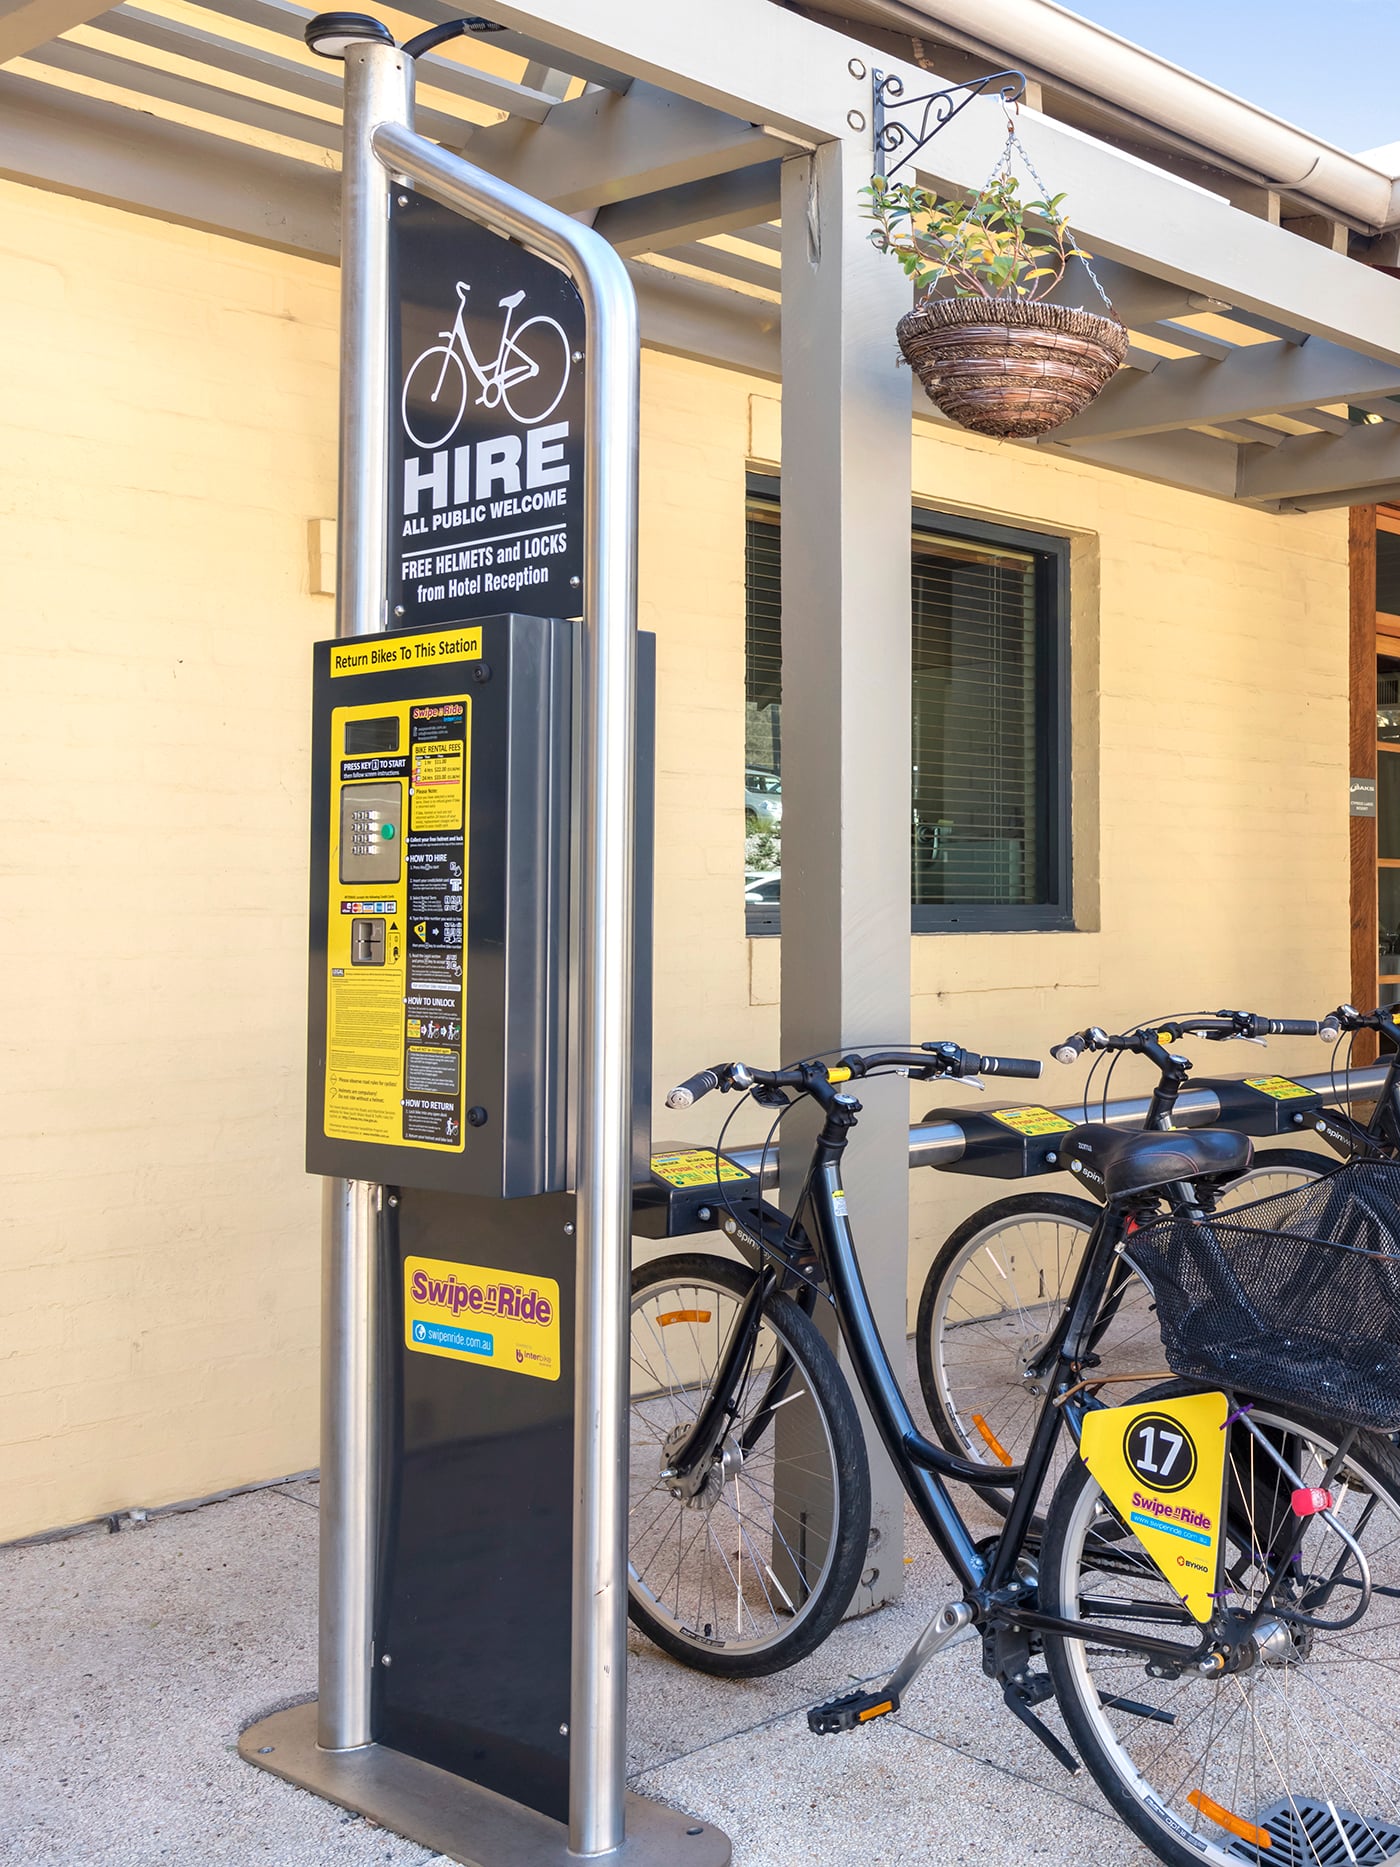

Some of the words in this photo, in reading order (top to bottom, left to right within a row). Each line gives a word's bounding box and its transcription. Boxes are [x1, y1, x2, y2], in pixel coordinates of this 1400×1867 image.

[404, 421, 570, 515] HIRE
[403, 517, 428, 536] ALL
[432, 505, 486, 530] PUBLIC
[490, 488, 566, 519] WELCOME
[402, 558, 432, 580] FREE
[436, 546, 493, 574] HELMETS
[496, 542, 520, 563] and
[524, 533, 567, 559] LOCKS
[418, 584, 445, 603] from
[449, 575, 480, 598] Hotel
[485, 566, 548, 592] Reception
[336, 656, 368, 669] Return
[371, 649, 396, 664] Bikes
[400, 646, 412, 660] To
[415, 643, 435, 658] This
[438, 638, 477, 654] Station
[344, 763, 360, 771] PRESS
[361, 761, 372, 769] KEY
[389, 759, 406, 767] START
[410, 854, 424, 862] HOW
[425, 854, 433, 862] TO
[434, 854, 448, 862] HIRE
[432, 998, 455, 1007] UNLOCK
[405, 1100, 420, 1108] HOW
[422, 1100, 429, 1108] TO
[430, 1101, 454, 1111] RETURN
[412, 1270, 483, 1314] Swipe
[498, 1285, 551, 1324] Ride
[428, 1329, 490, 1350] swipenride.com.au
[1136, 1426, 1184, 1477] 17
[1132, 1492, 1172, 1516] Swipe
[1181, 1508, 1211, 1529] Ride
[1186, 1560, 1208, 1572] BYKKO
